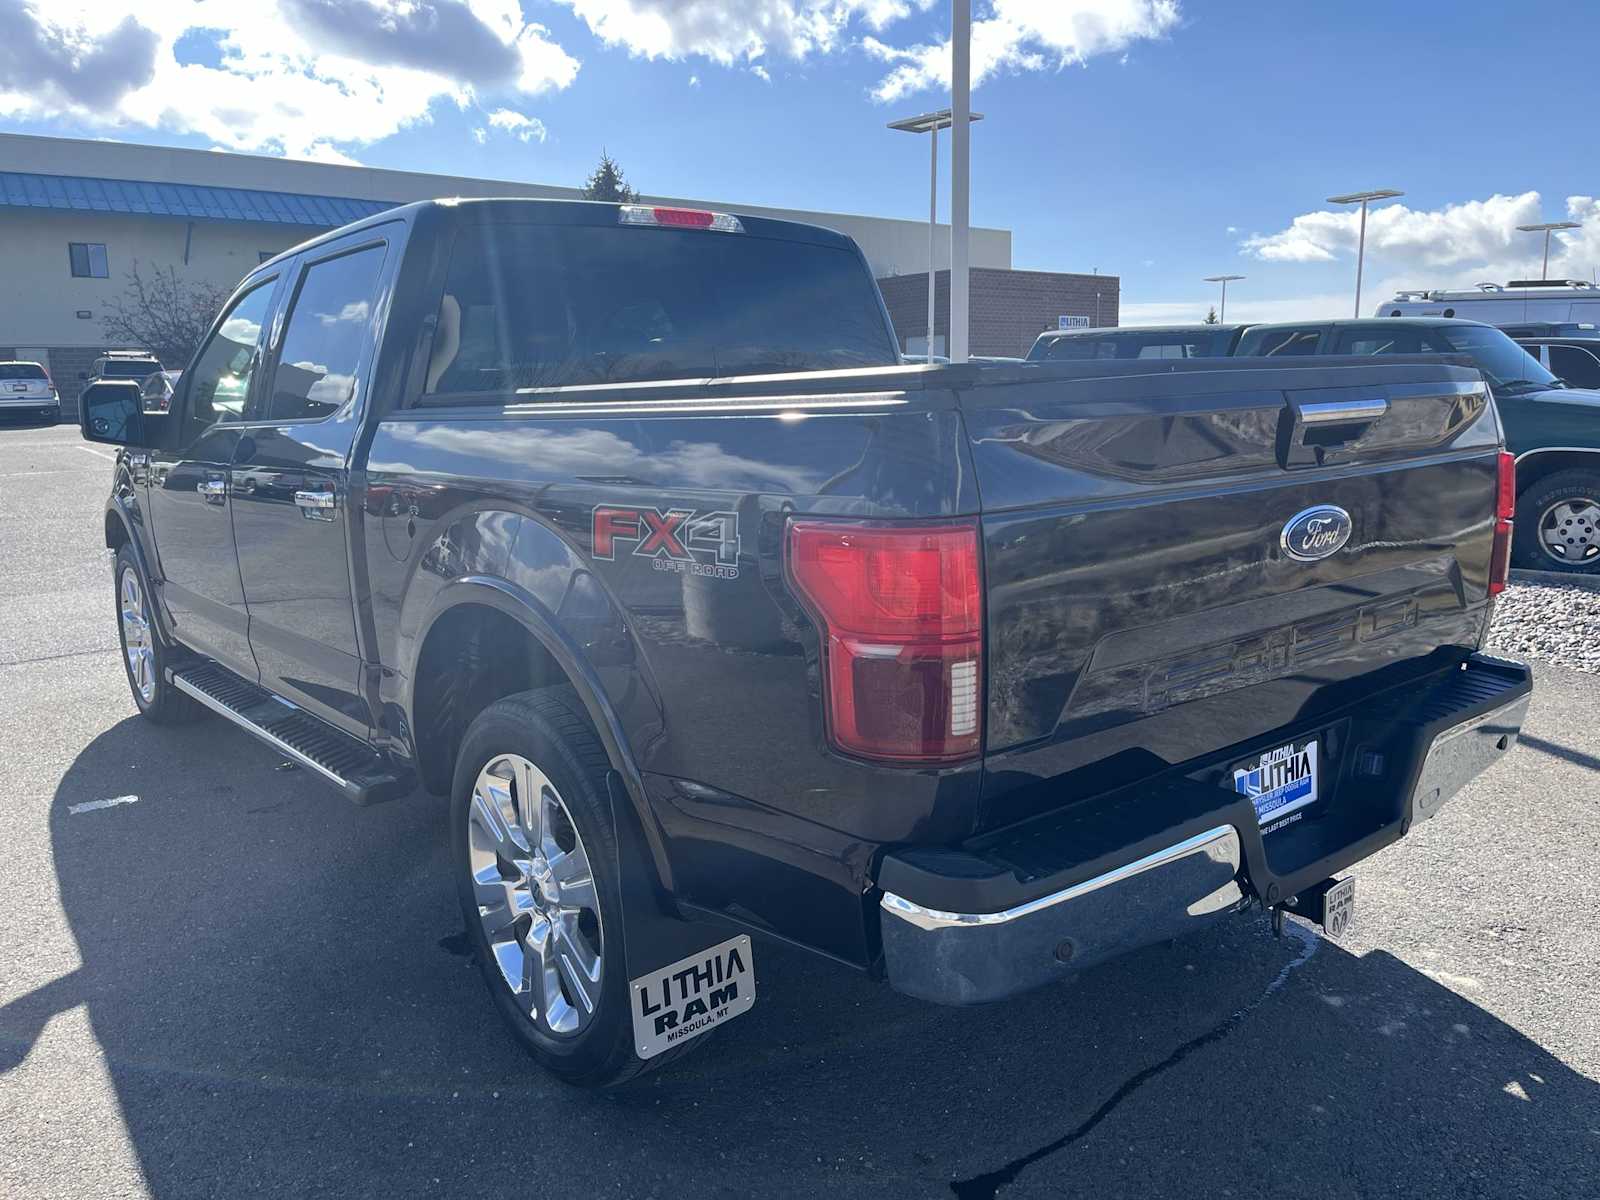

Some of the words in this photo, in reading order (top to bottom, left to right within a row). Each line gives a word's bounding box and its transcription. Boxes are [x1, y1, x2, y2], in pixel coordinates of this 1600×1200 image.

[1066, 317, 1089, 327] LITHIA
[592, 504, 740, 566] FX4
[1302, 518, 1341, 550] Ford
[652, 559, 686, 572] OFF
[691, 565, 739, 579] ROAD
[1267, 743, 1295, 763] LITHIA
[1260, 752, 1312, 793] LITHIA
[1259, 796, 1287, 815] MISSOULA
[1329, 894, 1352, 913] RAM
[641, 948, 745, 1017] LITHIA
[654, 982, 738, 1036] RAM
[667, 1014, 714, 1042] MISSOULA,
[716, 1007, 729, 1020] MT
